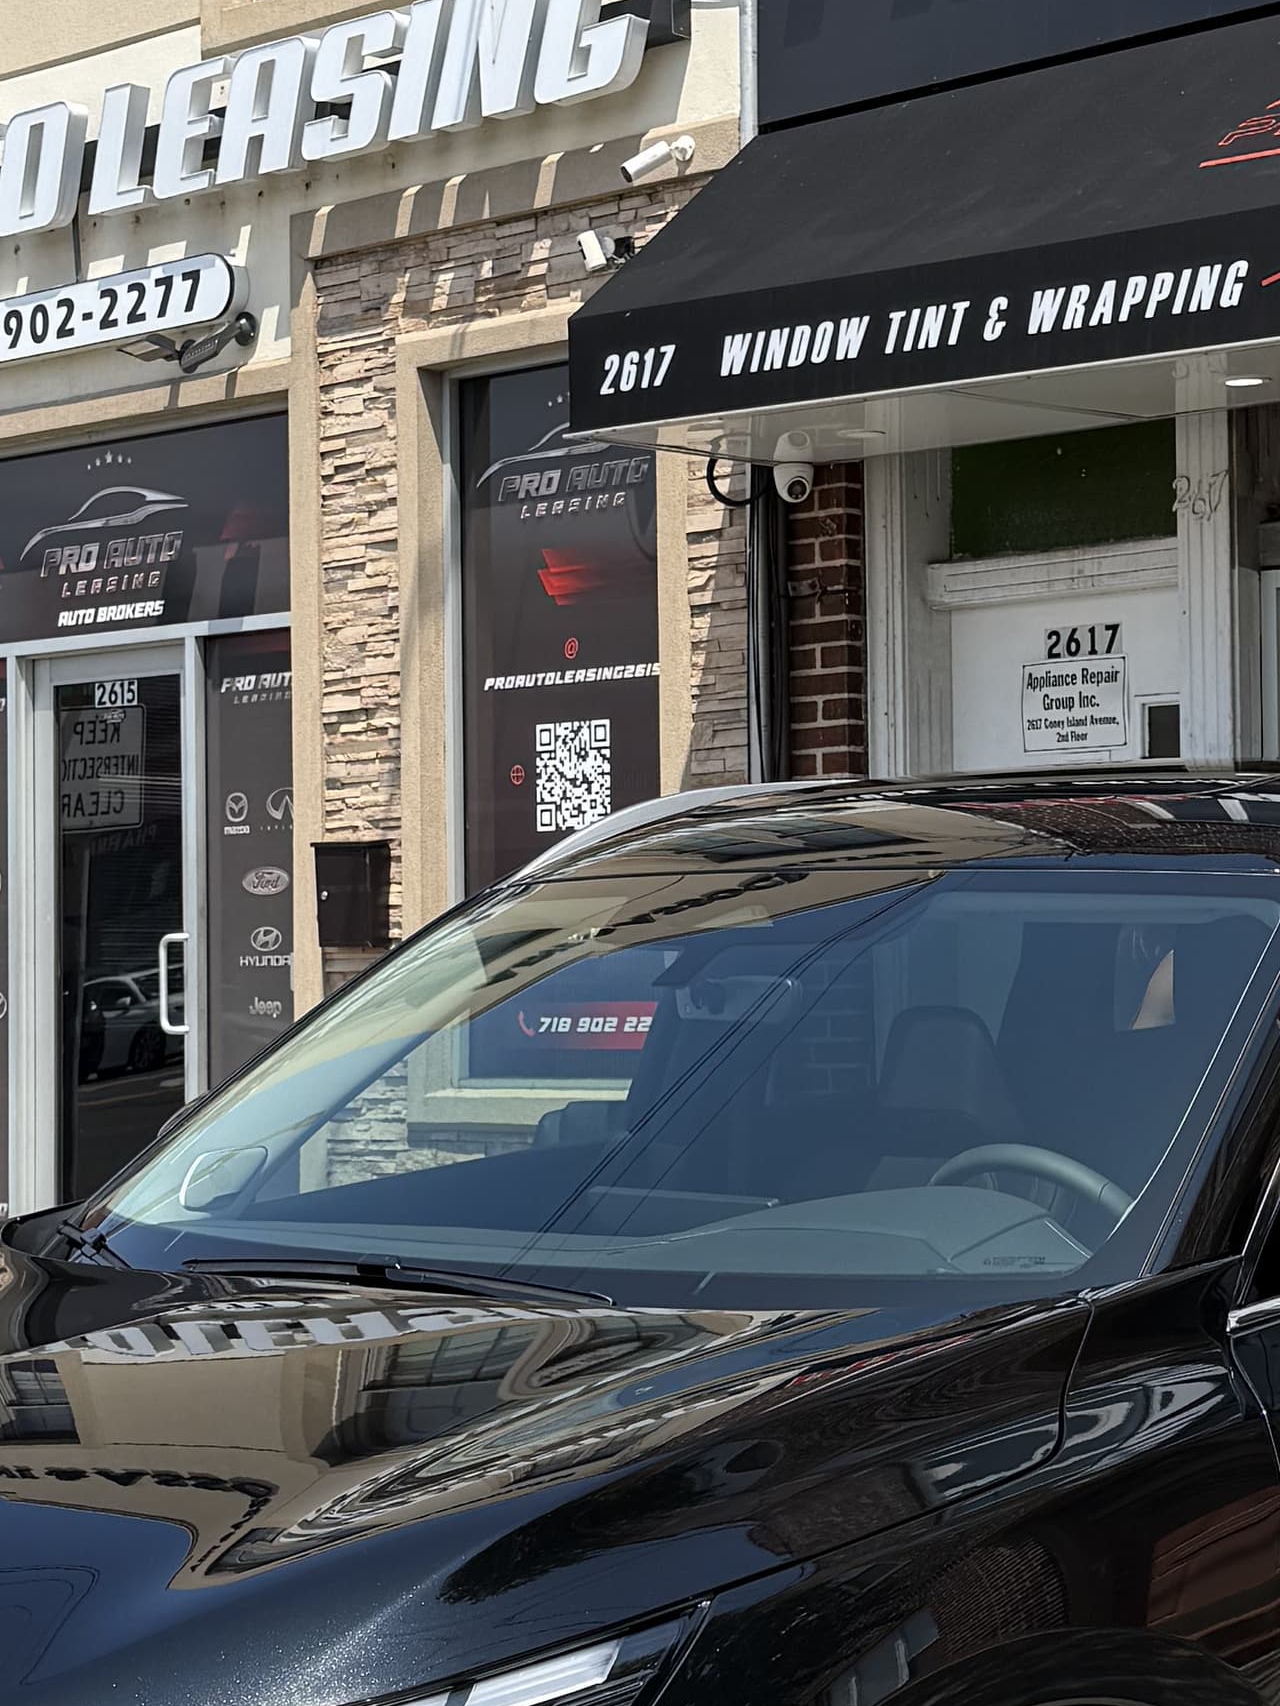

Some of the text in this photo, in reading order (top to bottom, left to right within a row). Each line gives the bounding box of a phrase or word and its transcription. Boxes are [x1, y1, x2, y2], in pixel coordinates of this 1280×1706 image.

[600, 343, 676, 396] 2617
[720, 316, 870, 378] WINDOW
[883, 299, 970, 355] TINT
[982, 295, 1010, 343] &
[1026, 259, 1249, 336] WRAPPING
[498, 455, 652, 503] PRO AUTO
[520, 491, 627, 519] LEASING
[40, 529, 185, 579] PRO AUTO
[61, 570, 162, 599] LEASING
[57, 599, 166, 628] AUTO BROKERS
[1047, 623, 1120, 660] 2617
[220, 671, 293, 694] PRO AUT
[484, 662, 661, 692] PROAUTOLEASING2615
[1026, 665, 1120, 692] Appliance Repair
[96, 682, 137, 707] 2615
[1042, 690, 1100, 712] Group Inc.
[1027, 718, 1042, 731] 2617
[1044, 718, 1065, 731] Coney
[1067, 715, 1088, 728] Island
[1056, 730, 1088, 743] 2nd Floor
[252, 870, 281, 891] Ford
[249, 996, 282, 1019] Jeep
[538, 1015, 653, 1033] 718 902 22
